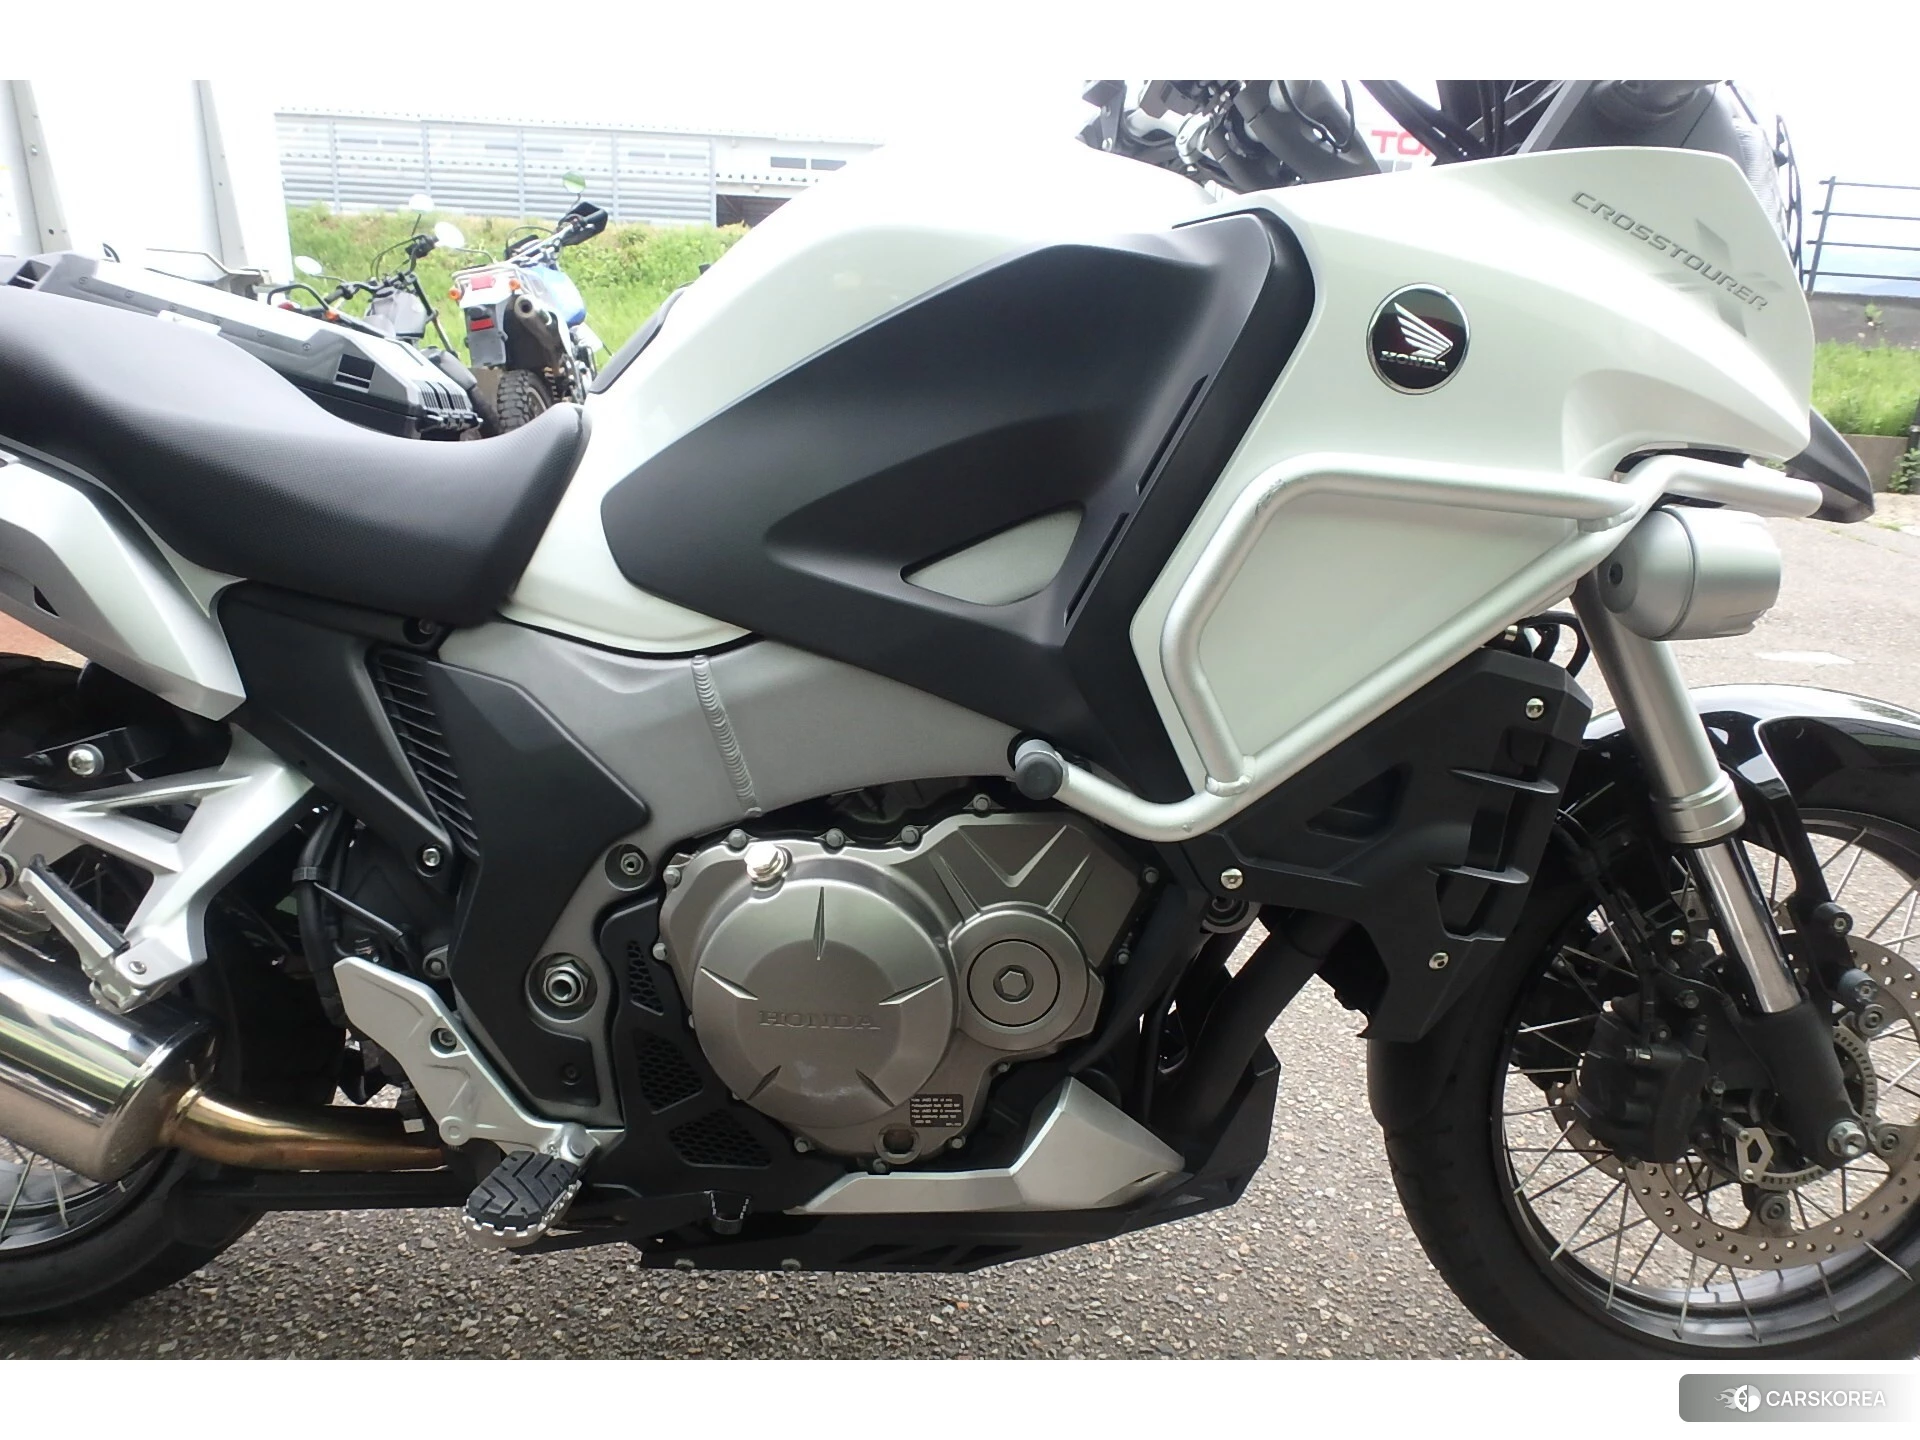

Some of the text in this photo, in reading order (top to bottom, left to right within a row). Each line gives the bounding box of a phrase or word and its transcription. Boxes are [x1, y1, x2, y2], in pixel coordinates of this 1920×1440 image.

[1571, 191, 1768, 311] CROSSTOURER
[1380, 350, 1448, 372] HONDA
[759, 1010, 881, 1030] HONDA
